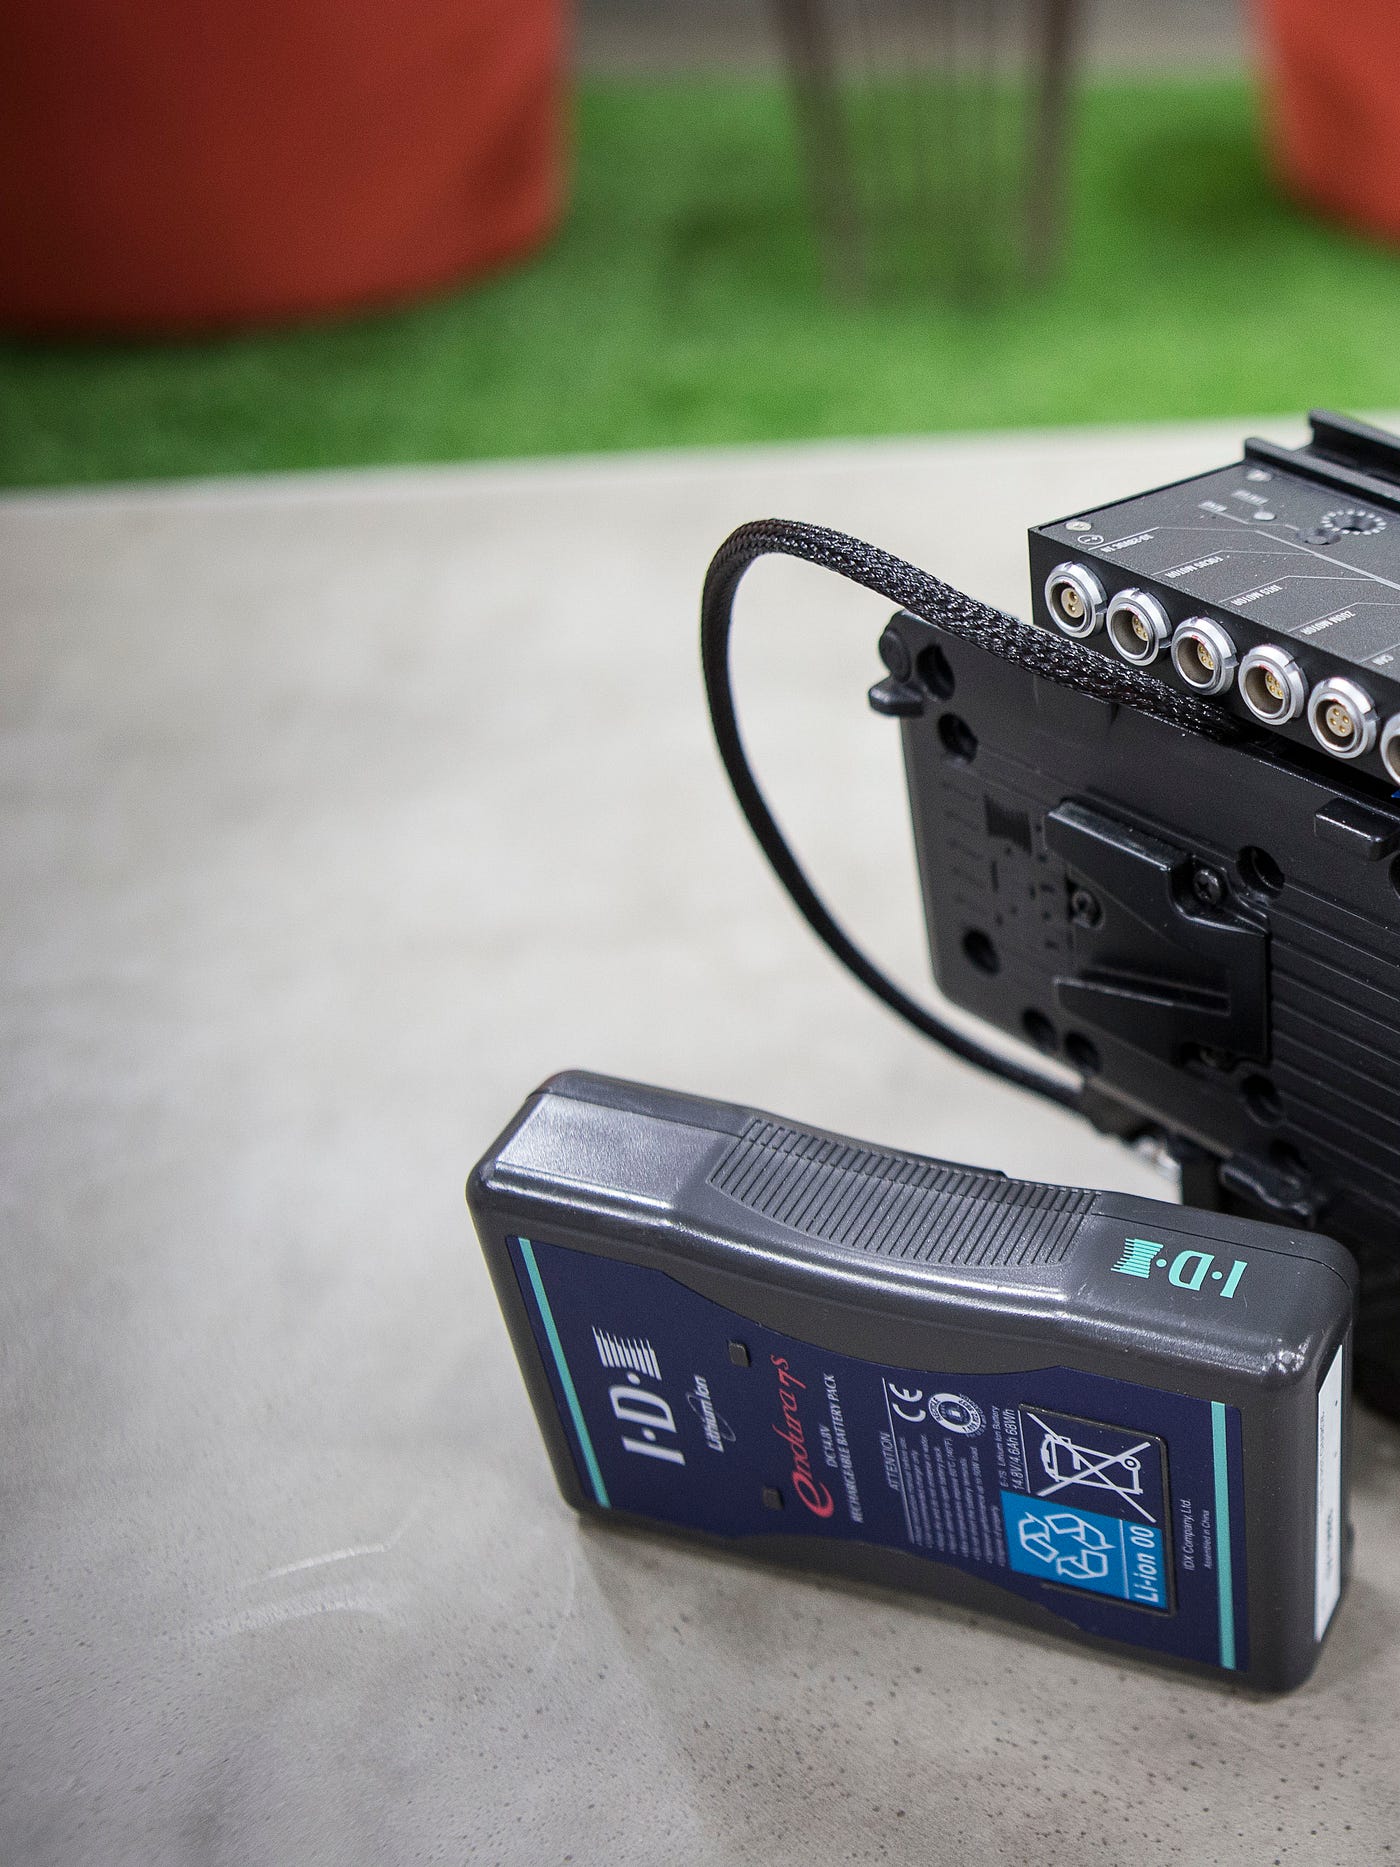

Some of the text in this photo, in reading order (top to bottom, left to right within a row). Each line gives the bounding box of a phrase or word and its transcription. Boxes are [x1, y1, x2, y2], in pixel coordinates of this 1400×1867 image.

[1162, 564, 1198, 578] MOTOR
[1228, 584, 1283, 605] IRIS MOTOR
[1297, 610, 1357, 635] ZOOM MOTOR
[693, 1374, 724, 1452] Lithium Ion
[822, 1372, 864, 1523] RECHARGEABLE BATTERY PACK
[878, 1431, 901, 1491] ATTENTION
[1001, 1406, 1025, 1491] 14.8V/4.6Ah 68Wh
[1200, 1508, 1211, 1529] China
[1129, 1523, 1160, 1604] Li-ion 00
[1182, 1553, 1195, 1571] IDX
[1201, 1535, 1213, 1570] Assembled
